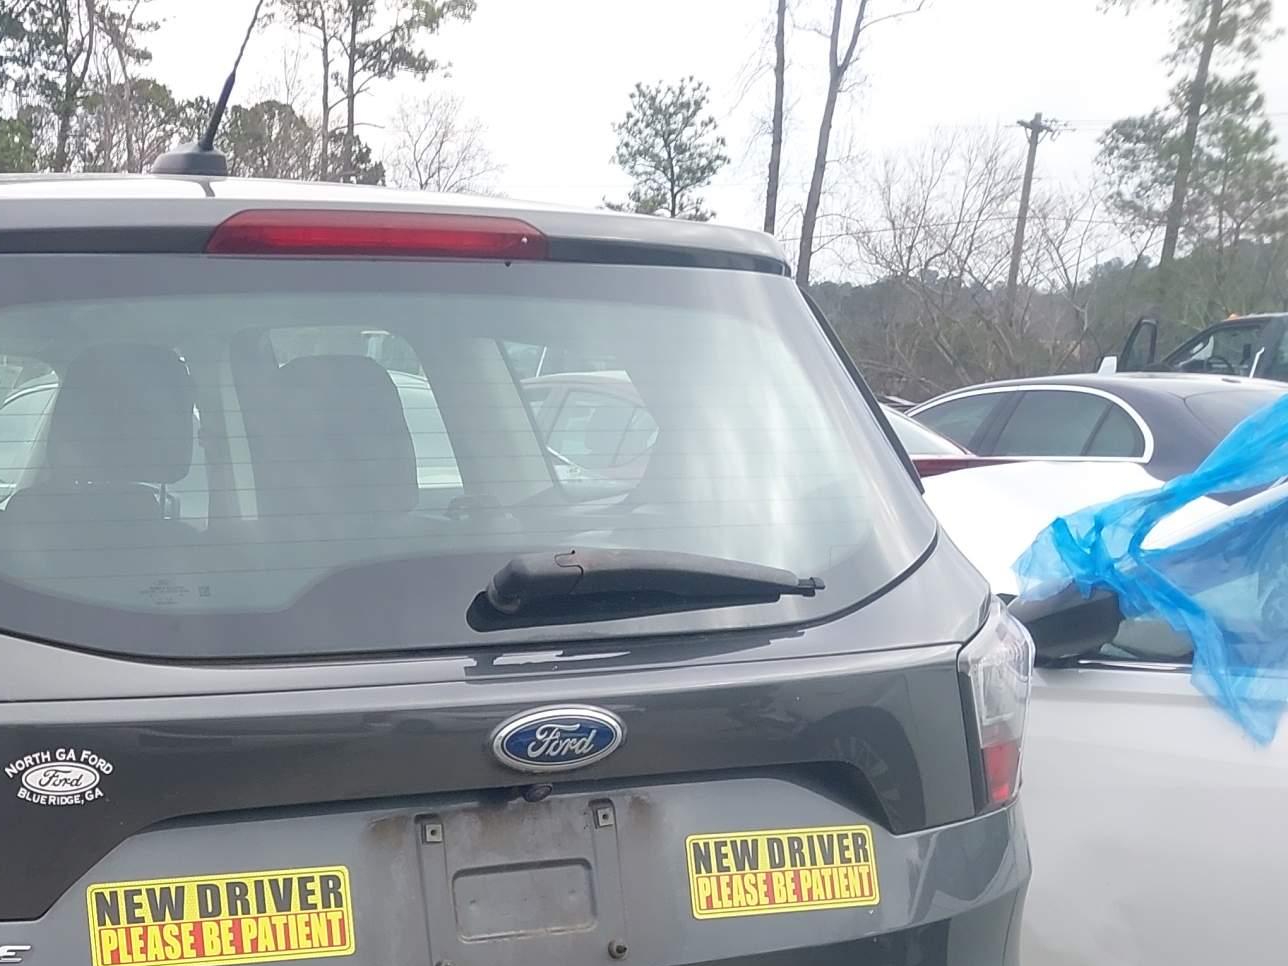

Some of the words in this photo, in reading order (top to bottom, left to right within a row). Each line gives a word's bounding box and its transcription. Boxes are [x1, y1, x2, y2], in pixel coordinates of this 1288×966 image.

[527, 723, 597, 758] Ford
[4, 750, 51, 779] NORTH
[55, 748, 77, 761] GA
[80, 749, 114, 776] FORD
[39, 769, 84, 787] Ford
[84, 787, 104, 801] GA
[694, 838, 760, 874] NEW
[767, 832, 870, 869] DRIVER
[95, 885, 186, 928] NEW
[196, 874, 344, 919] DRIVER
[698, 872, 770, 910] PLEASE
[772, 869, 799, 904] BE
[799, 866, 871, 902] PATIENT
[100, 922, 197, 966] PLEASE
[201, 918, 237, 957] BE
[242, 911, 344, 954] PATIENT
